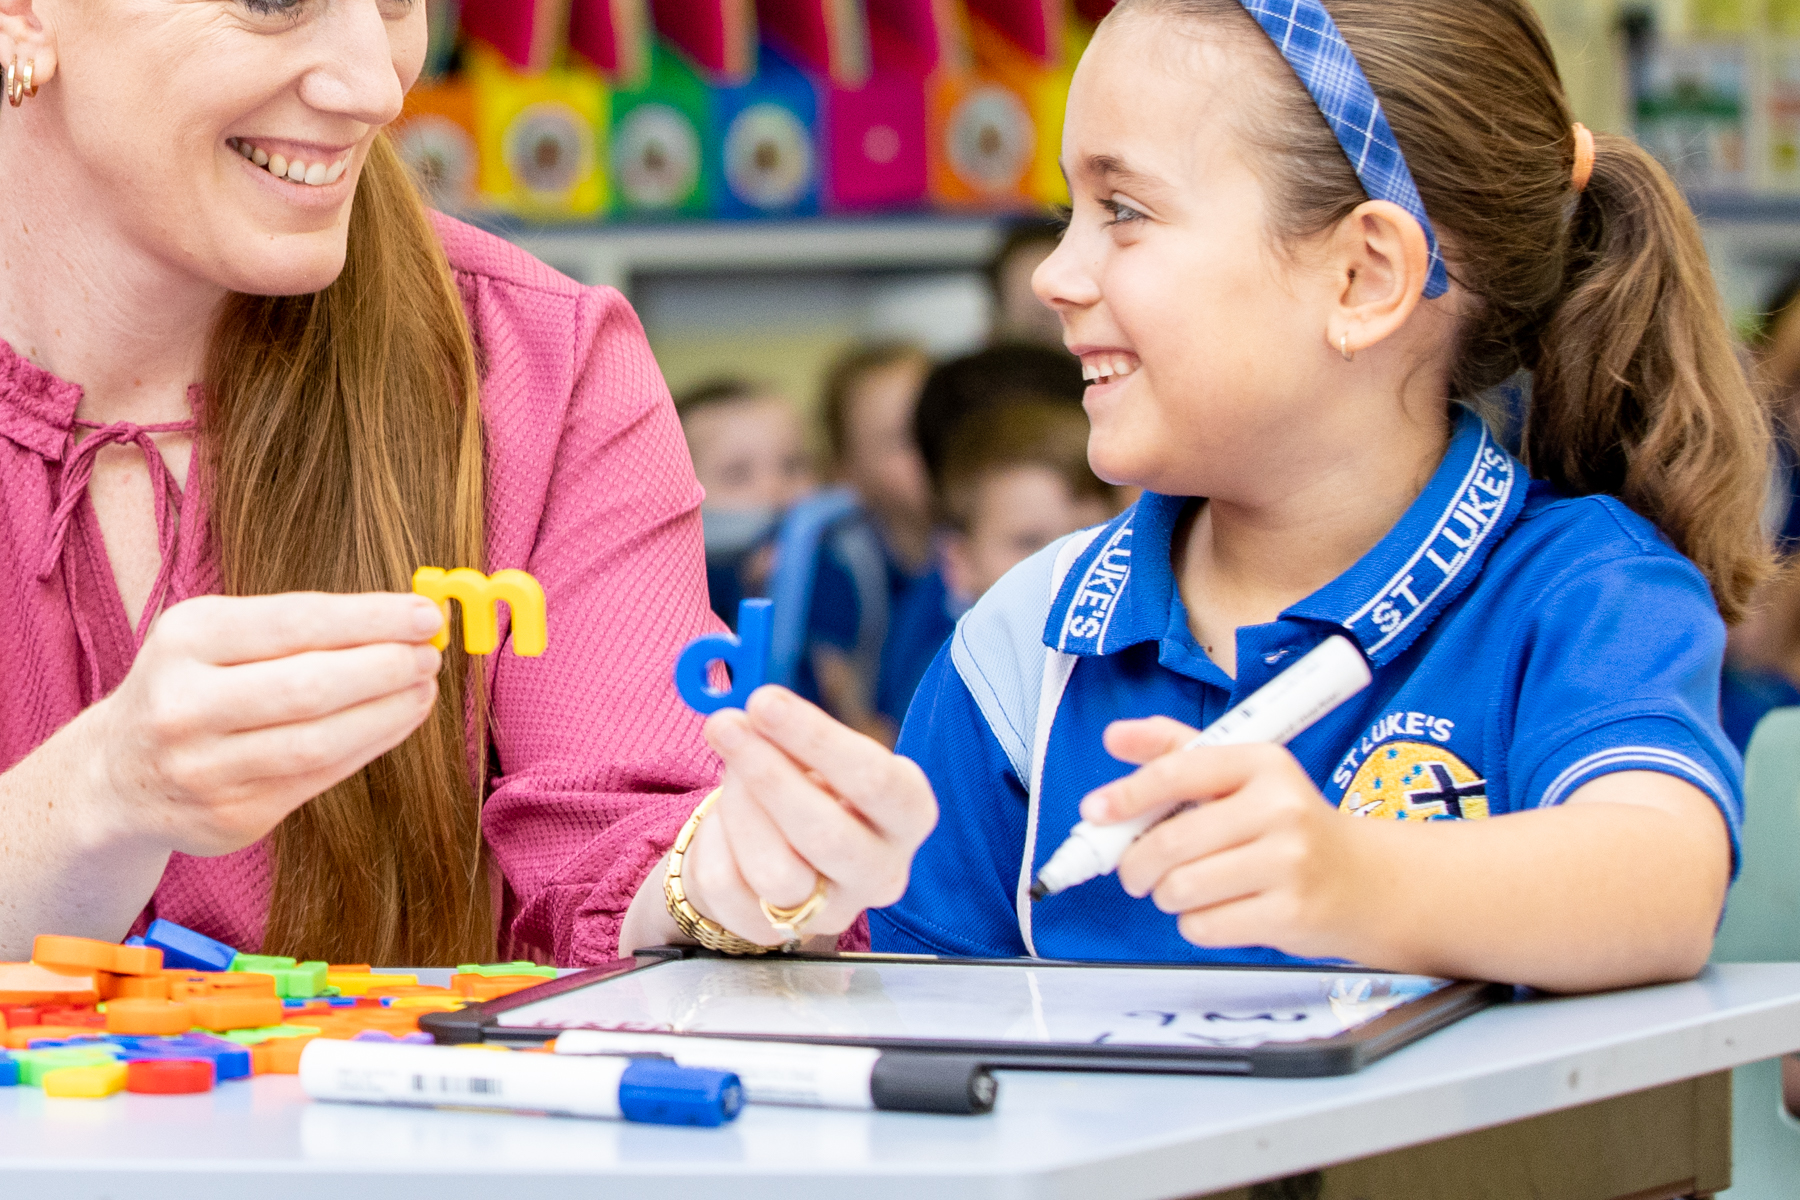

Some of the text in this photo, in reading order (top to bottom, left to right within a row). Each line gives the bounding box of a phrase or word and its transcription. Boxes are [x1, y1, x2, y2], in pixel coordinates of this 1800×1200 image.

[1069, 528, 1134, 638] LUKE'S
[1371, 447, 1508, 633] ST LUKE'S
[1333, 747, 1359, 790] ST
[1361, 711, 1455, 754] LUKE'S
